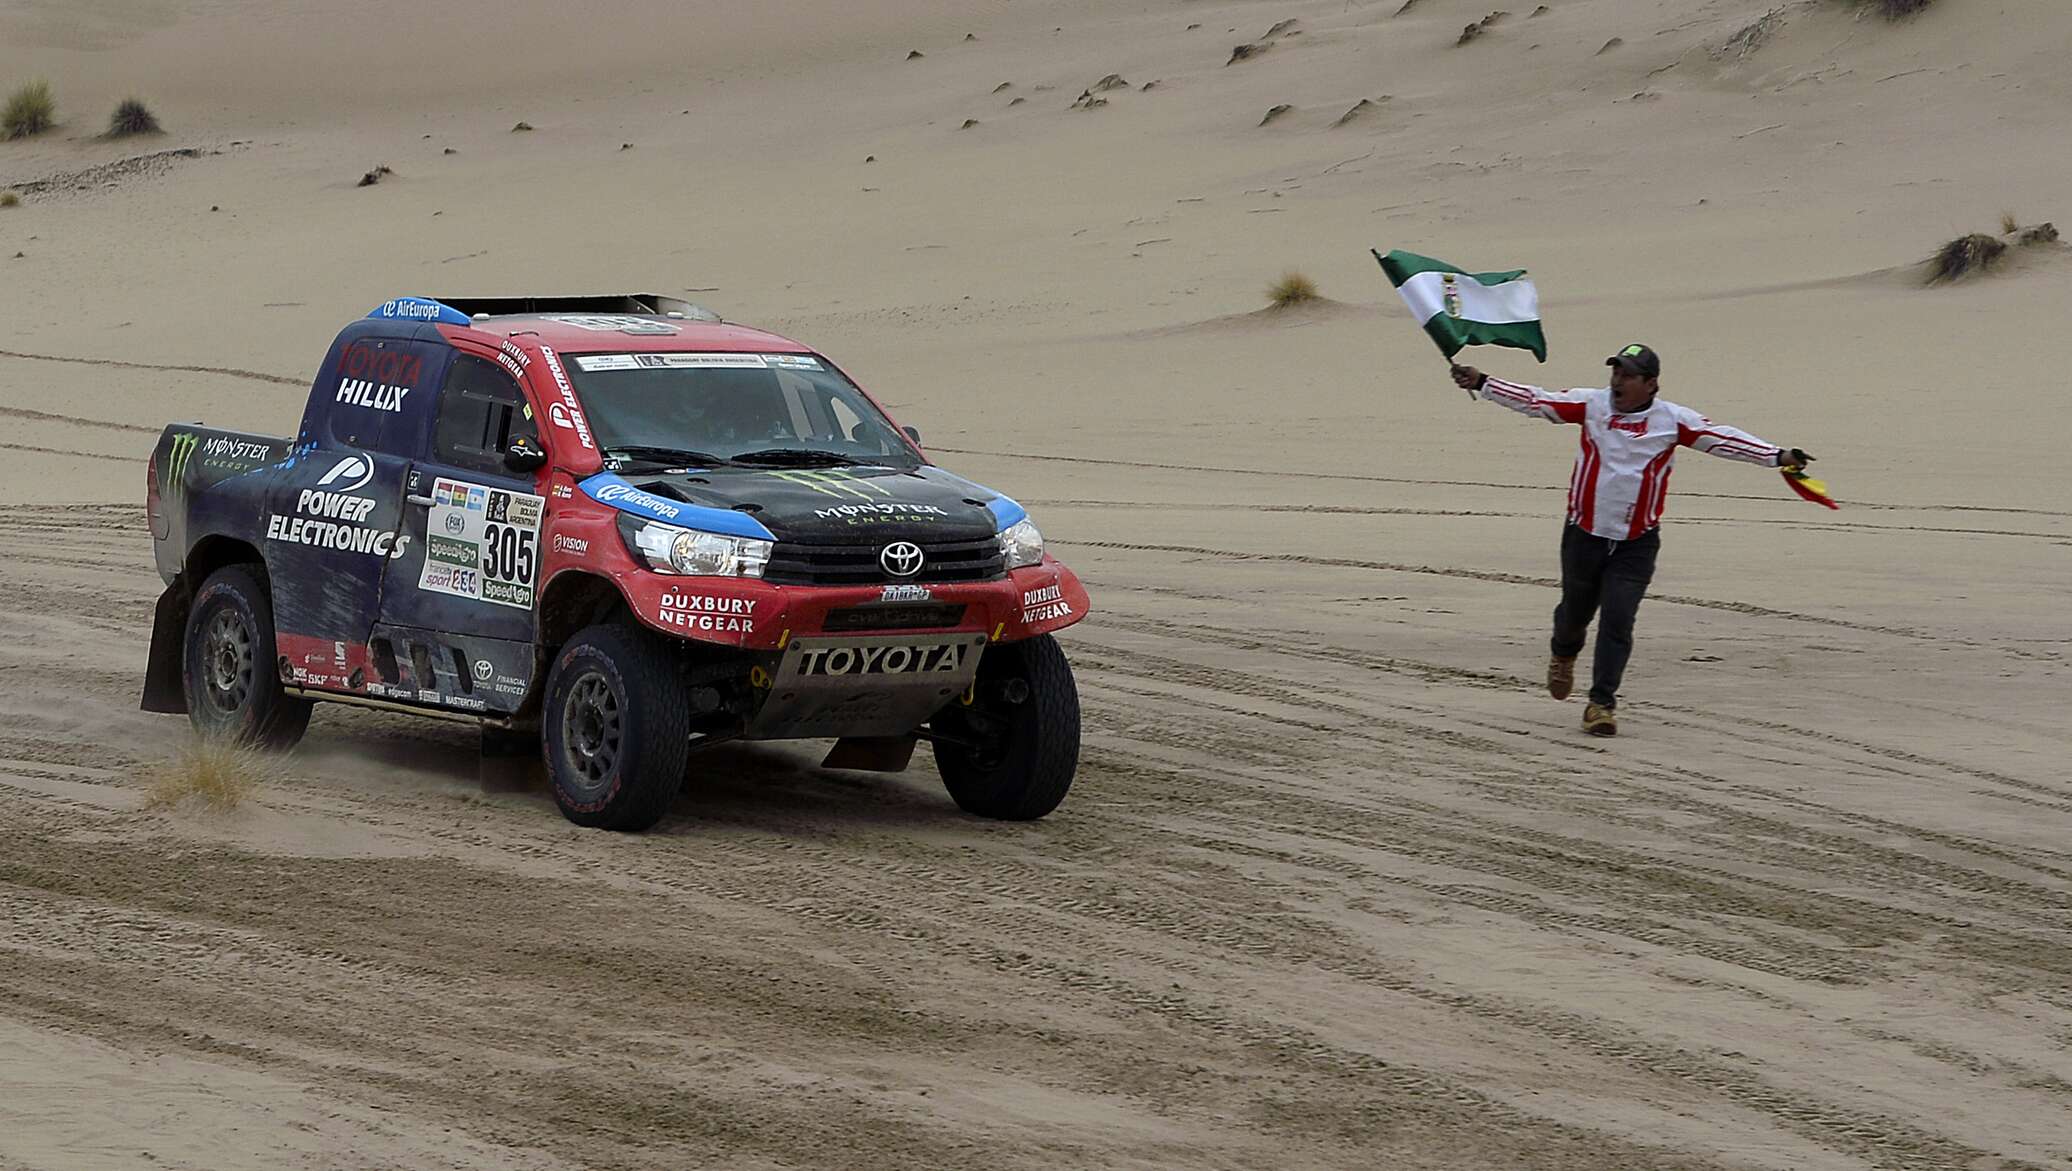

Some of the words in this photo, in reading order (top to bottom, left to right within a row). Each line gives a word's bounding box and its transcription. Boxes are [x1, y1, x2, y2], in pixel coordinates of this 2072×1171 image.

[336, 344, 422, 388] TOYOTA
[502, 340, 531, 367] DUXBURY
[541, 345, 577, 408] ELECTRONICS
[336, 378, 409, 412] HILUX
[570, 409, 593, 449] POWER
[204, 459, 250, 471] ENERGY
[297, 489, 376, 522] POWER
[848, 515, 934, 525] ENERGY
[266, 514, 411, 559] ELECTRONICS
[561, 536, 589, 552] VISION
[483, 524, 534, 584] 305
[661, 594, 756, 613] DUXBURY
[1024, 585, 1061, 605] DUXBURY
[660, 610, 753, 632] NETGEAR
[1021, 602, 1073, 623] NETGEAR
[803, 645, 960, 676] TOYOTA
